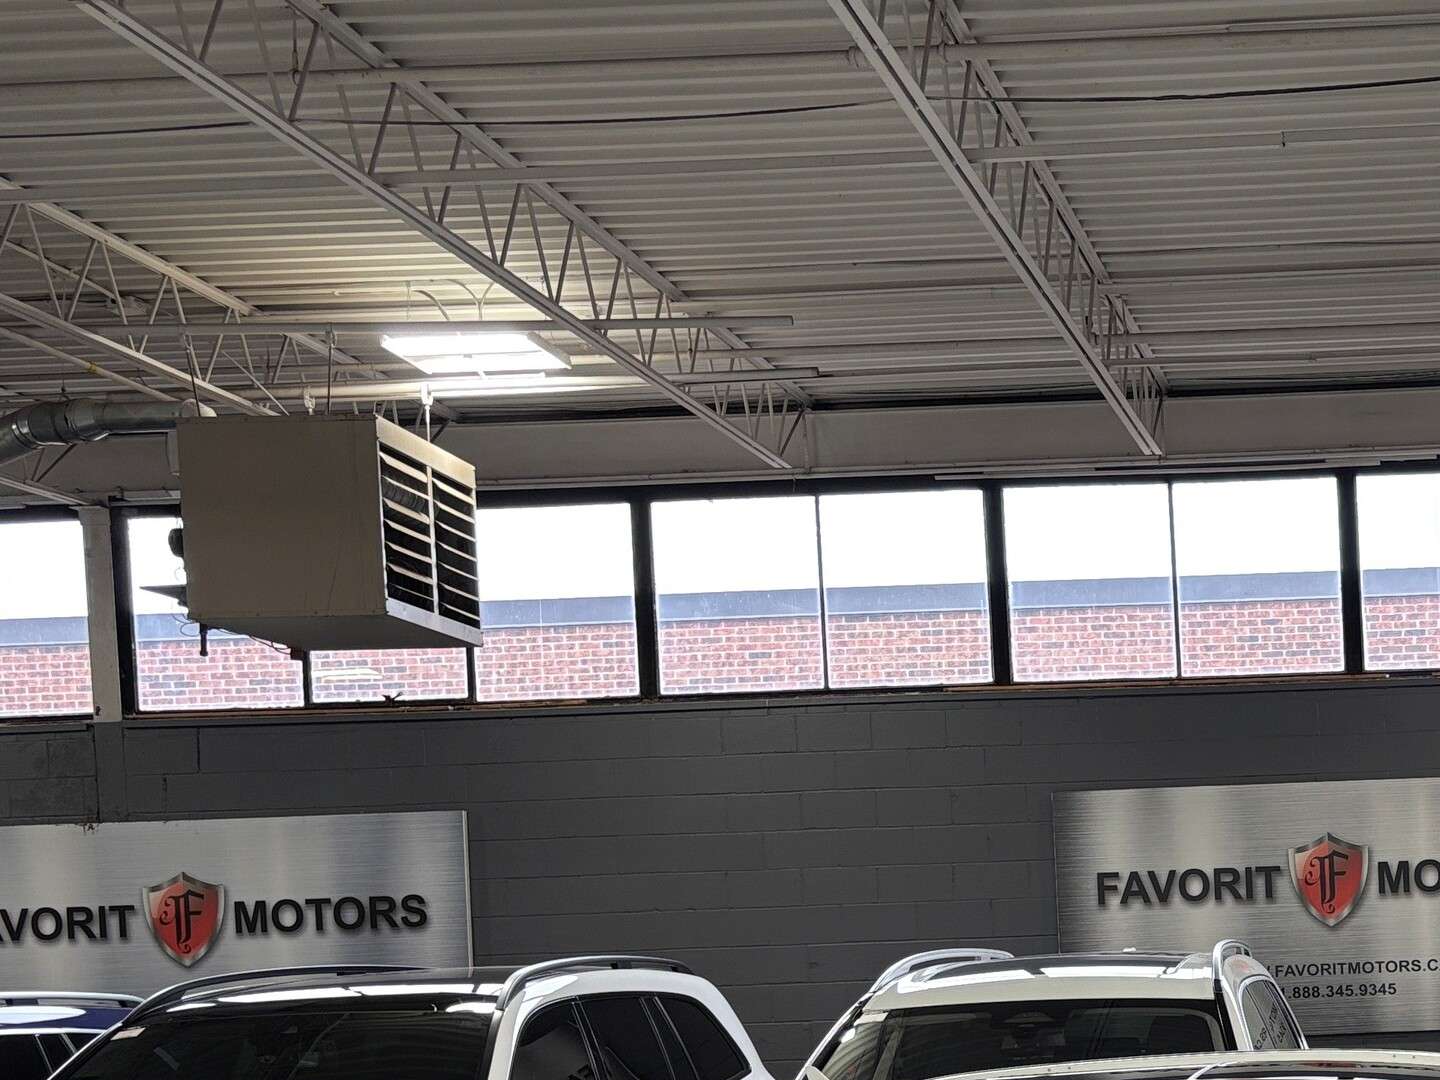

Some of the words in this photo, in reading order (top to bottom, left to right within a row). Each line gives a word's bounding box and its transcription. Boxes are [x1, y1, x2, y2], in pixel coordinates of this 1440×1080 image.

[1096, 865, 1281, 905] FAVORIT
[0, 904, 136, 942] VORIT
[233, 894, 428, 934] MOTORS
